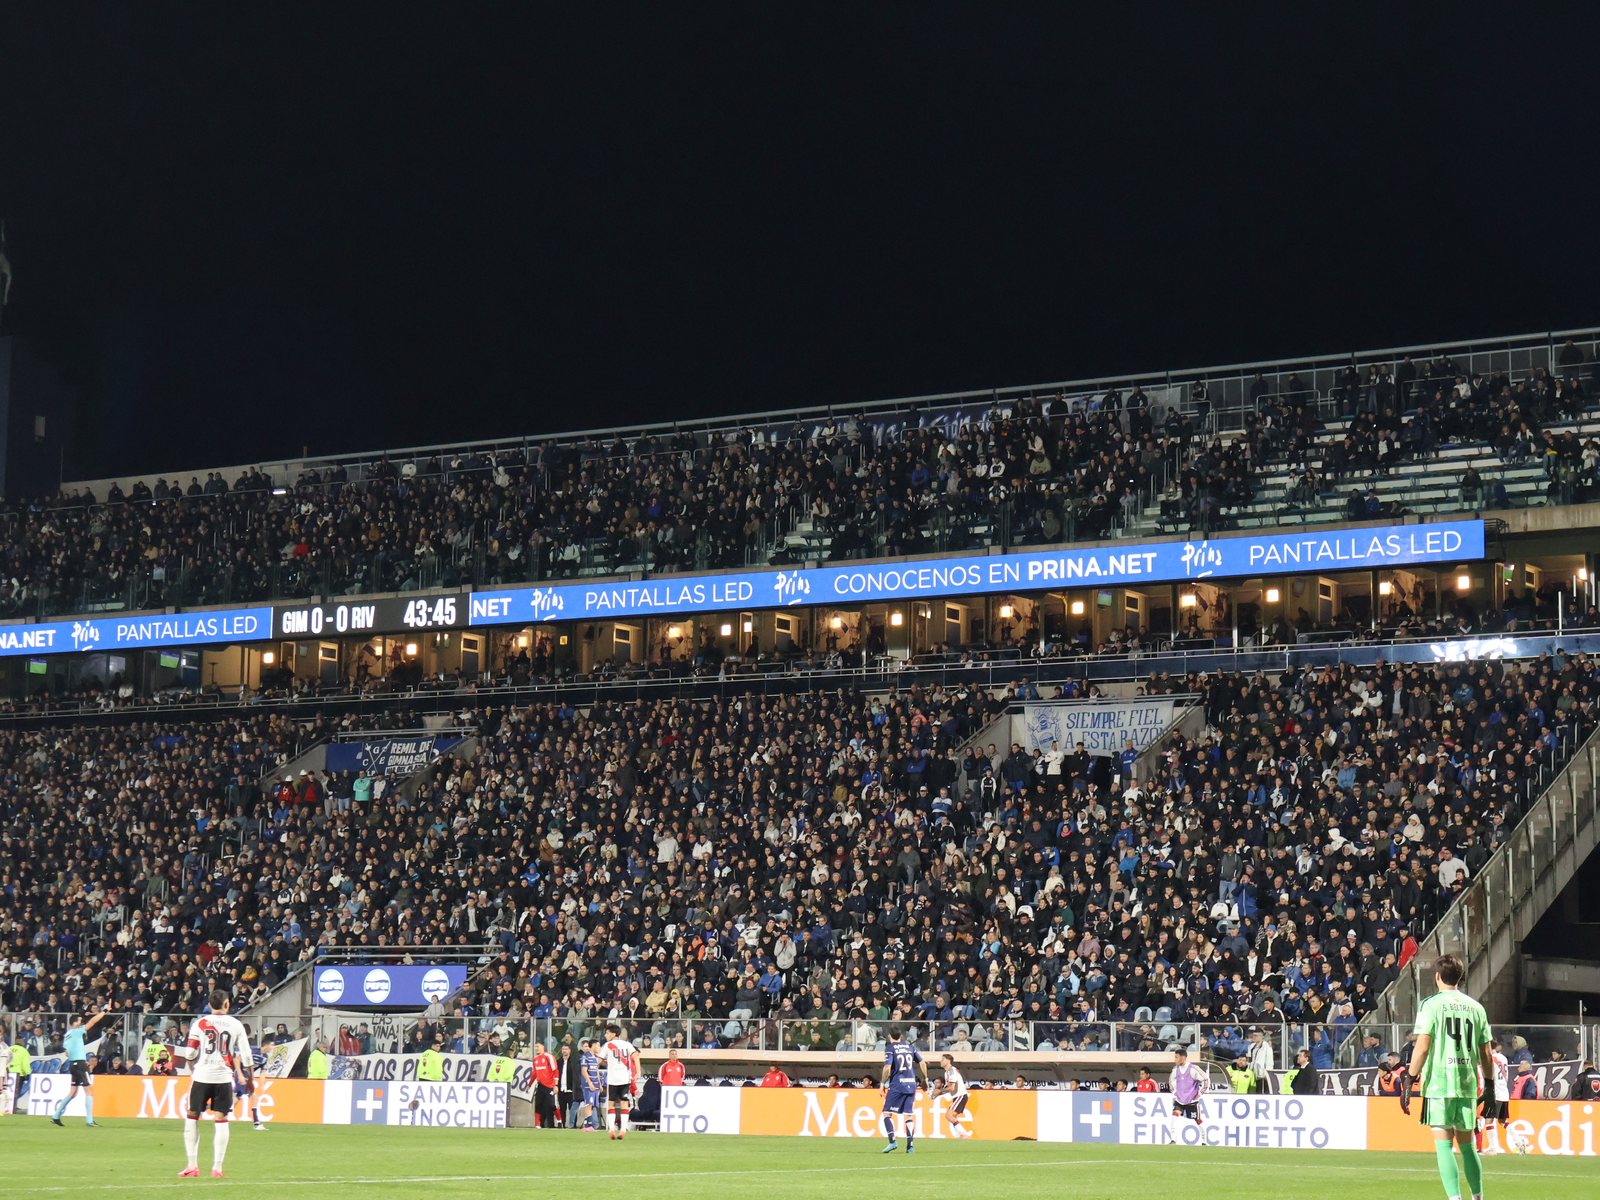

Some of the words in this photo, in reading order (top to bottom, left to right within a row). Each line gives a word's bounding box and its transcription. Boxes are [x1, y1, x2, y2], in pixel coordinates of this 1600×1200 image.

[585, 585, 706, 611] PANTALLAS
[713, 581, 753, 603] LED
[834, 564, 981, 595] CONOCENOS
[989, 561, 1020, 584] EN
[1027, 552, 1157, 581] PRINA.NET
[1249, 535, 1401, 566] PANTALLAS
[1410, 530, 1462, 554] LED
[282, 610, 308, 633] GIM
[311, 607, 322, 634] 0
[336, 605, 348, 632] 0
[351, 605, 375, 629] RIV
[403, 597, 456, 627] 43:45
[117, 618, 218, 642] PANTALLAS
[223, 616, 258, 636] LED
[1066, 710, 1126, 730] SIEMPRE
[1128, 707, 1164, 727] FIEL
[1064, 732, 1075, 749] A
[1081, 731, 1116, 751] ESTA
[1120, 724, 1163, 748] RAZÓ
[205, 1029, 232, 1056] 30
[1445, 1016, 1473, 1052] 41
[363, 1058, 397, 1082] LOS
[454, 1059, 481, 1082] DE
[896, 1054, 913, 1071] 29
[399, 1084, 506, 1105] SANATOR
[665, 1089, 689, 1109] IO
[663, 1114, 709, 1134] TTO
